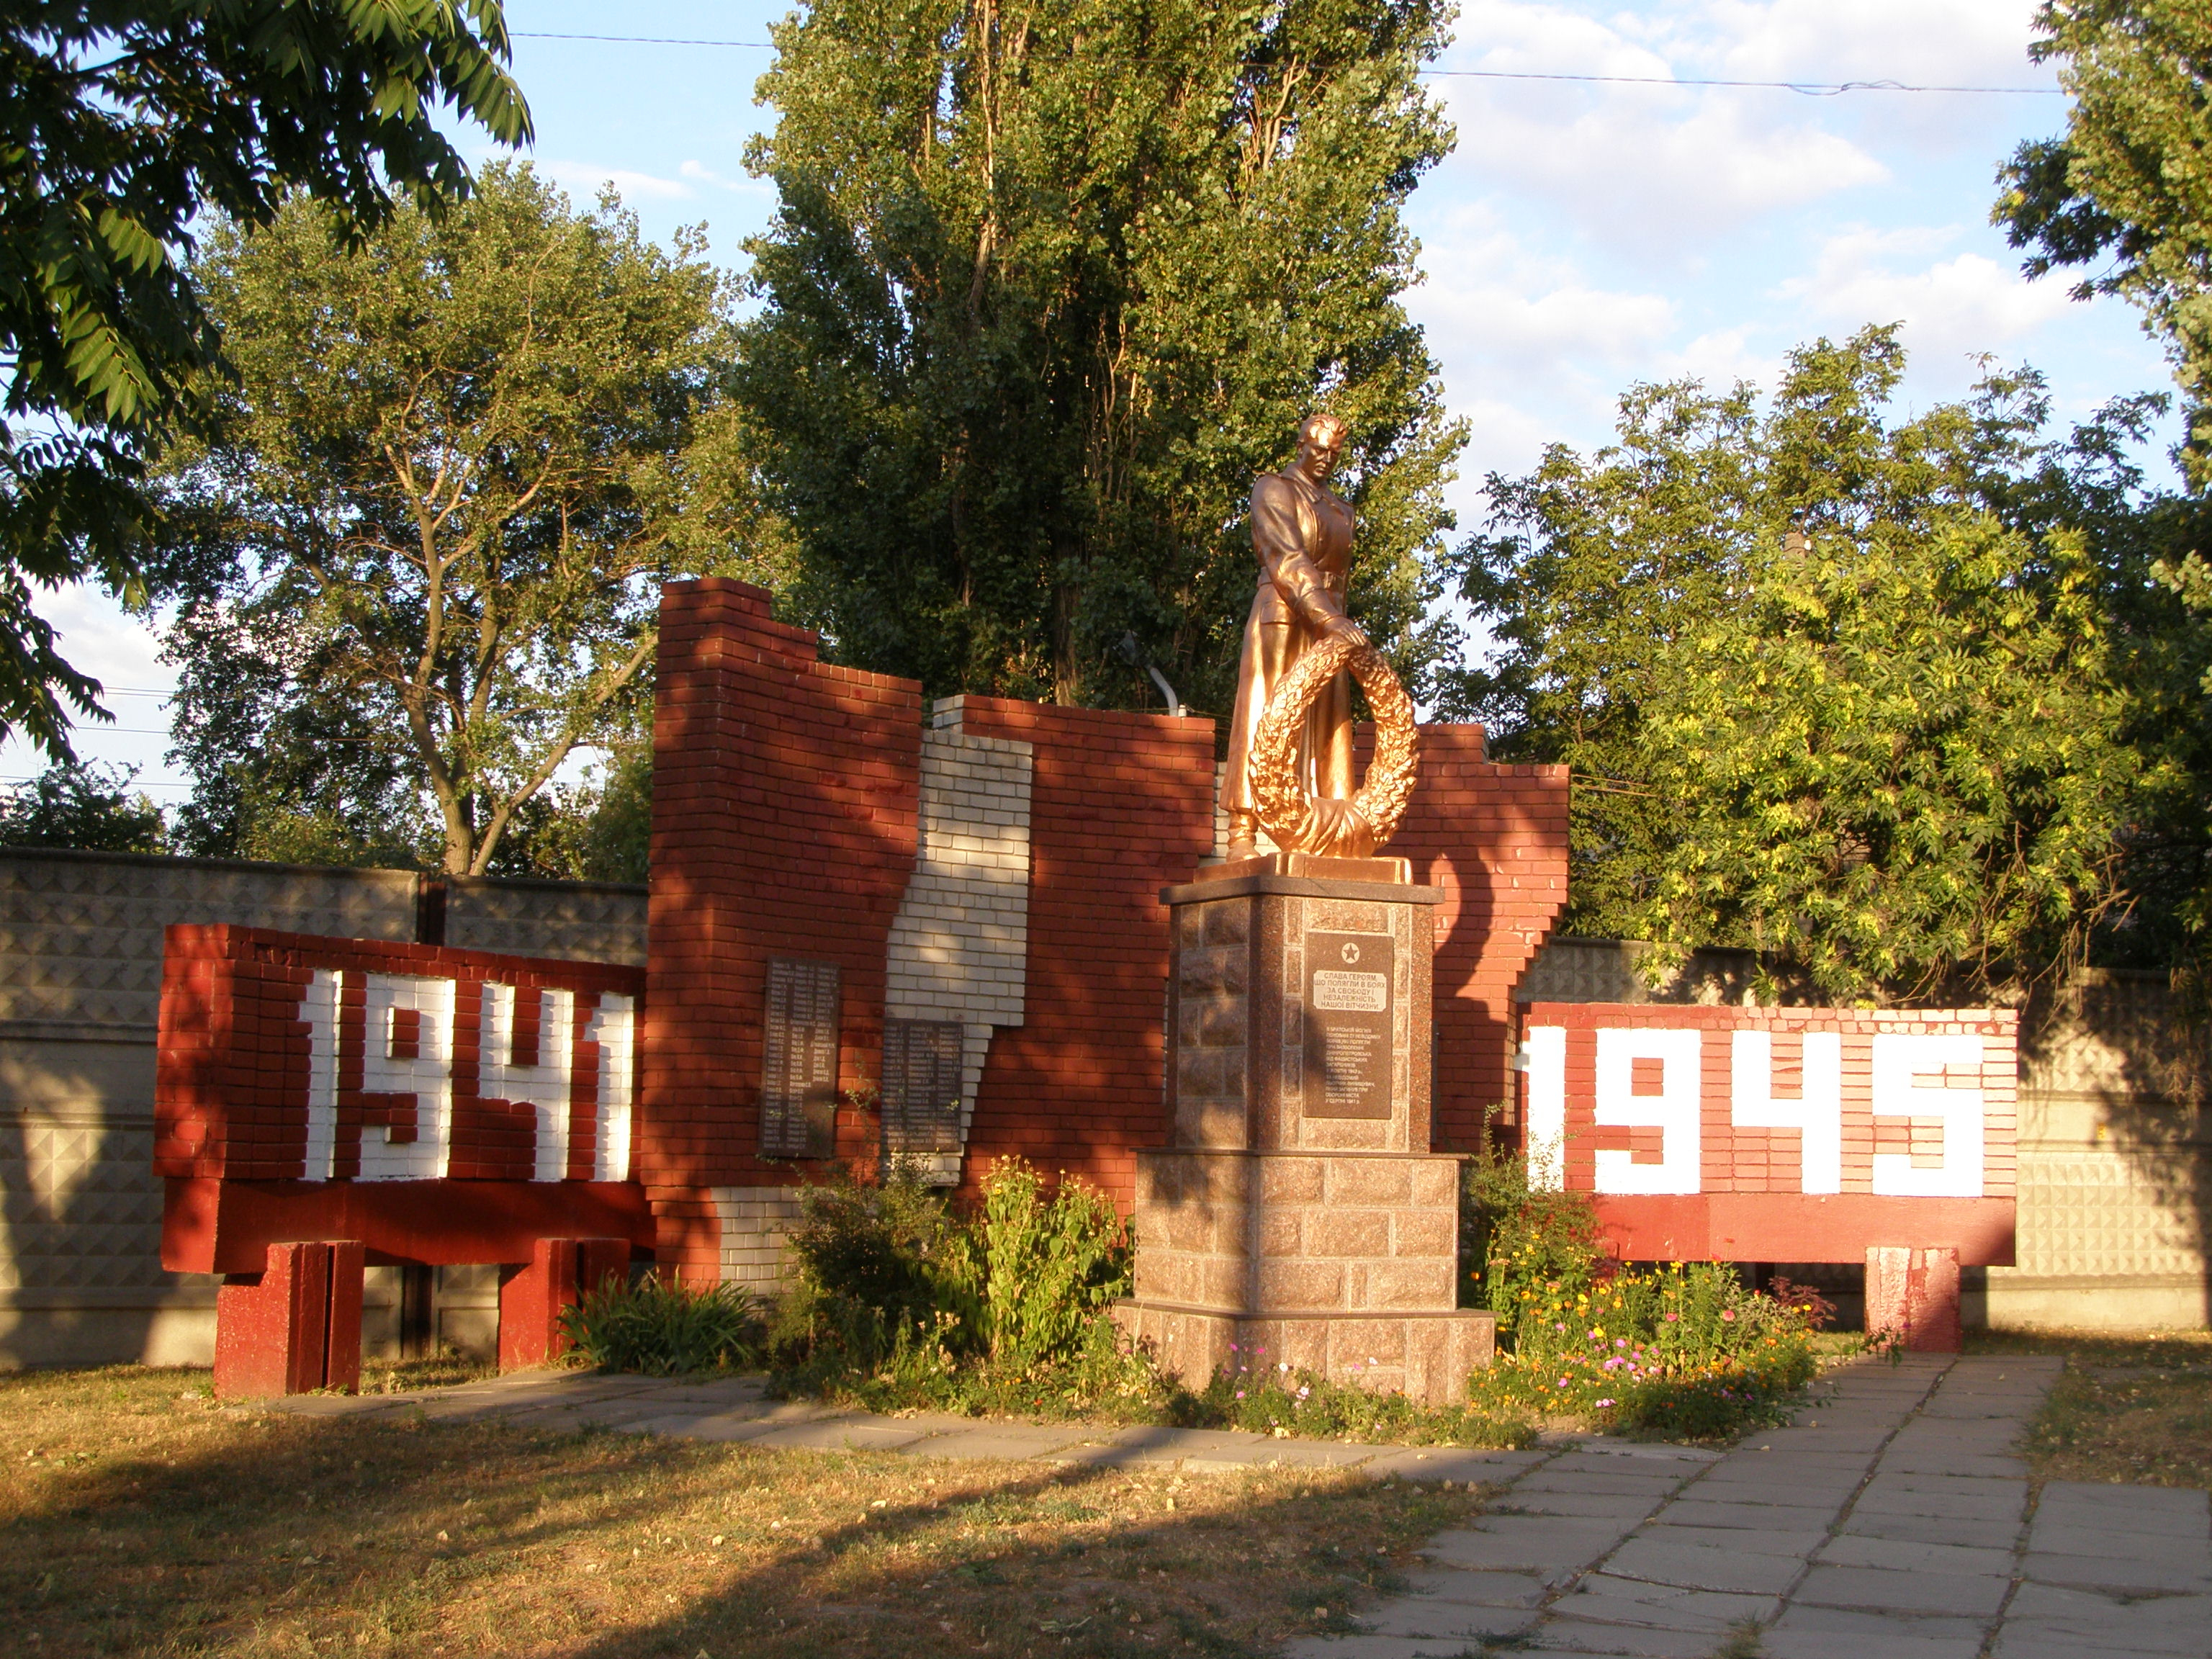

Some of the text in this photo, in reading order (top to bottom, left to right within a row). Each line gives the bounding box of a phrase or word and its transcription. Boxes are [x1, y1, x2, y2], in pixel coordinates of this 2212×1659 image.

[296, 968, 634, 1182] 1941
[1323, 994, 1376, 1003] НЕЗАЛЕЖНІСТЬ
[1514, 1026, 1984, 1197] 1945
